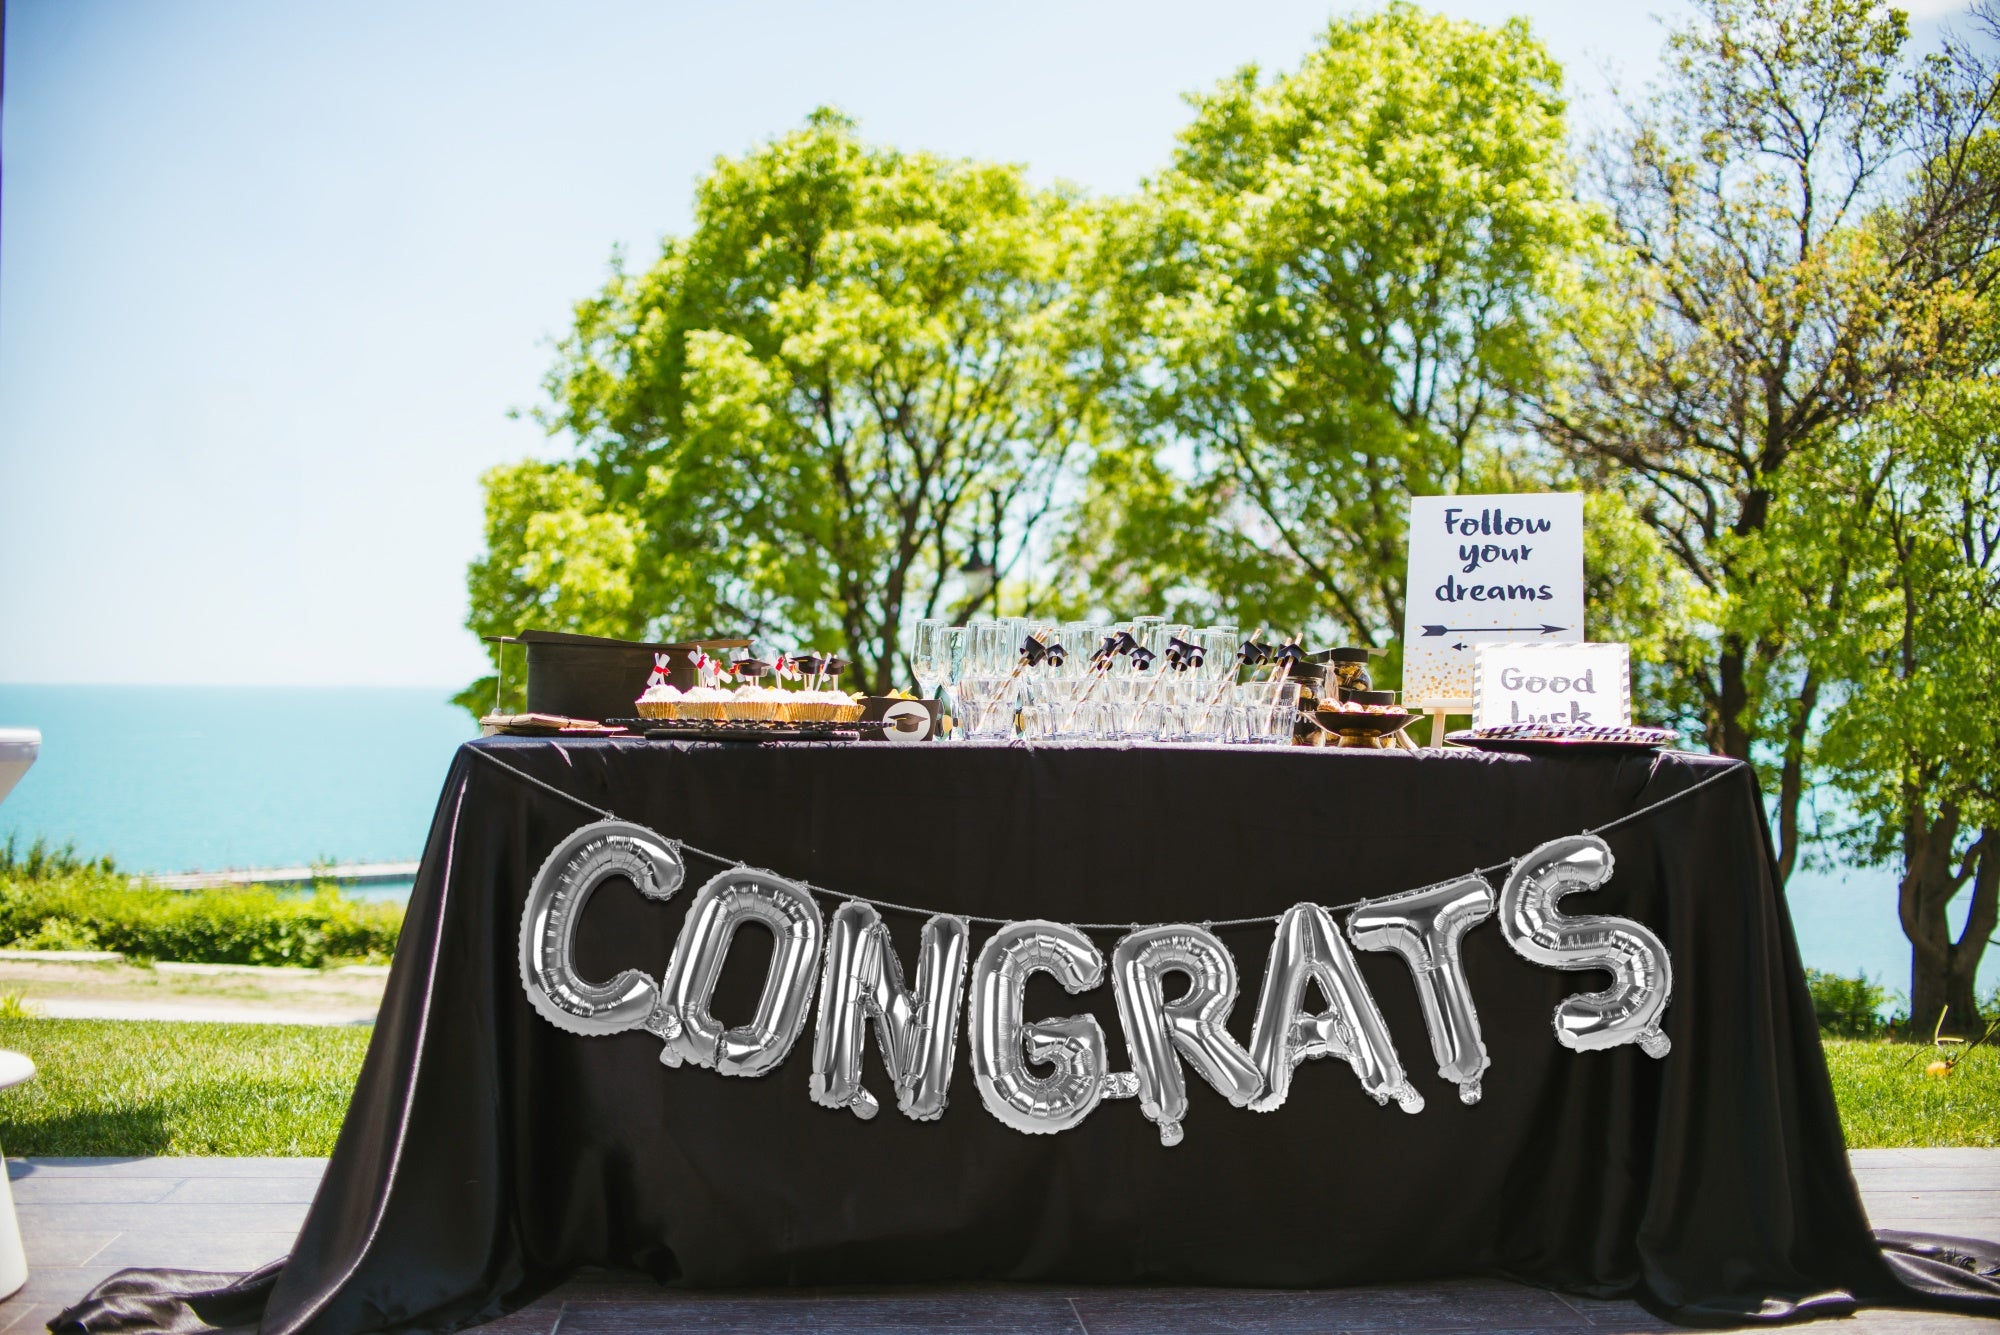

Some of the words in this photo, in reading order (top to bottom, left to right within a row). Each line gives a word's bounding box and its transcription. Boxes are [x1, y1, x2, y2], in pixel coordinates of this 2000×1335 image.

[1444, 508, 1551, 536] Follow
[1458, 544, 1533, 573] your
[1435, 574, 1553, 602] dreams
[1501, 667, 1596, 694] Good
[1510, 700, 1593, 725] Luck
[518, 818, 1674, 1147] CONGRATS
